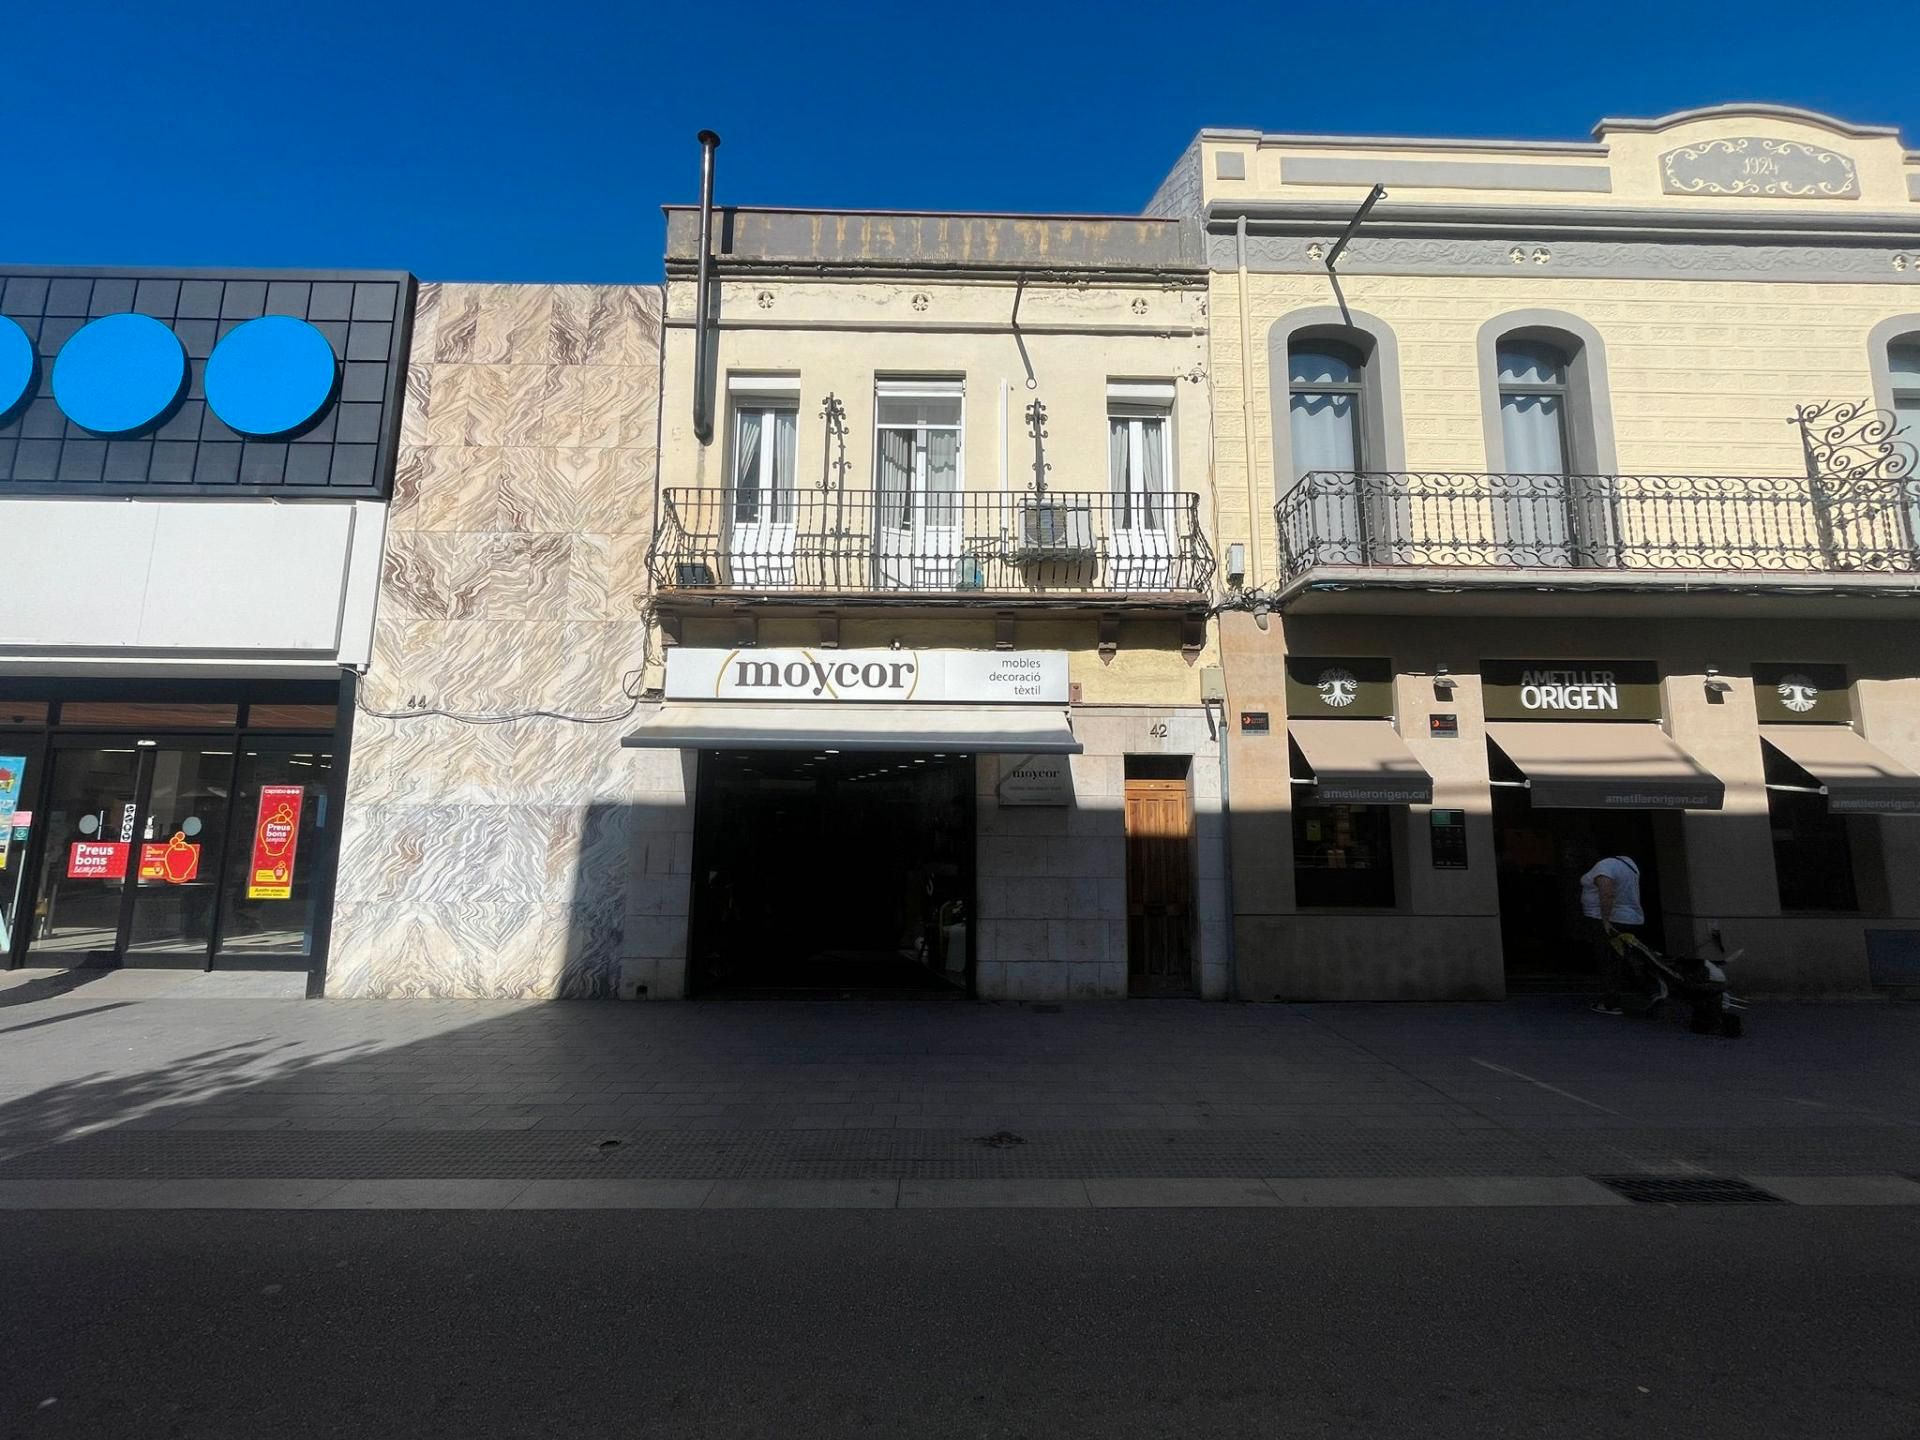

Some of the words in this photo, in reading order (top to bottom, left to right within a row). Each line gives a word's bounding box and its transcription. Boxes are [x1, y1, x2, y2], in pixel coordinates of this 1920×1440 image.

[1743, 157, 1778, 175] 1924
[1002, 657, 1042, 669] mobles
[734, 660, 915, 697] moycor
[989, 671, 1042, 683] decoració
[1521, 670, 1615, 687] AMETLLER
[1014, 684, 1042, 697] tèxtil
[407, 695, 427, 709] 44
[1520, 686, 1619, 711] ORIGEN
[1150, 724, 1168, 738] 42
[1012, 770, 1060, 780] moycor
[1323, 788, 1429, 801] ametllerorigen.cat
[267, 823, 291, 831] Preus
[77, 844, 115, 856] Preus
[75, 855, 108, 866] bons
[73, 865, 108, 877] sempre
